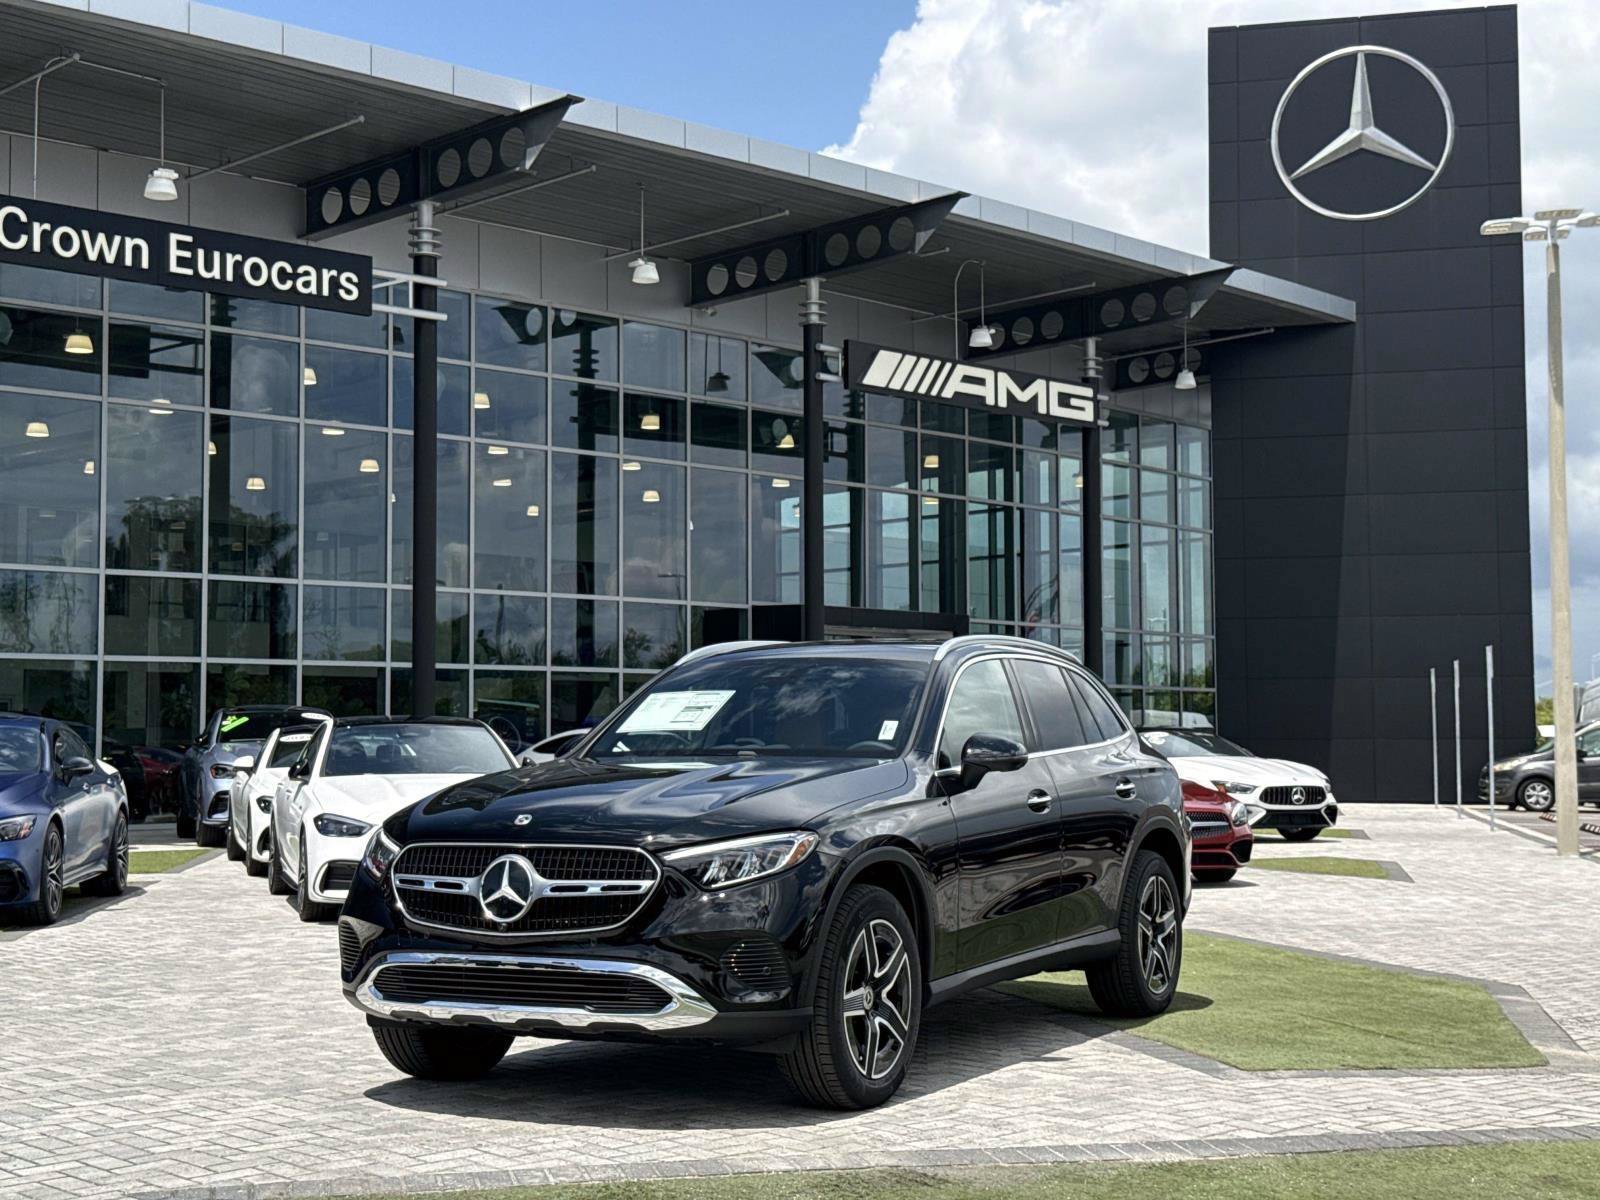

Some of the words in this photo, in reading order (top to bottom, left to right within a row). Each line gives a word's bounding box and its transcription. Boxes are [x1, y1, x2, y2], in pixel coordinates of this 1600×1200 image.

[0, 205, 150, 269] Crown
[169, 232, 360, 301] Eurocars
[941, 363, 1094, 422] AMG
